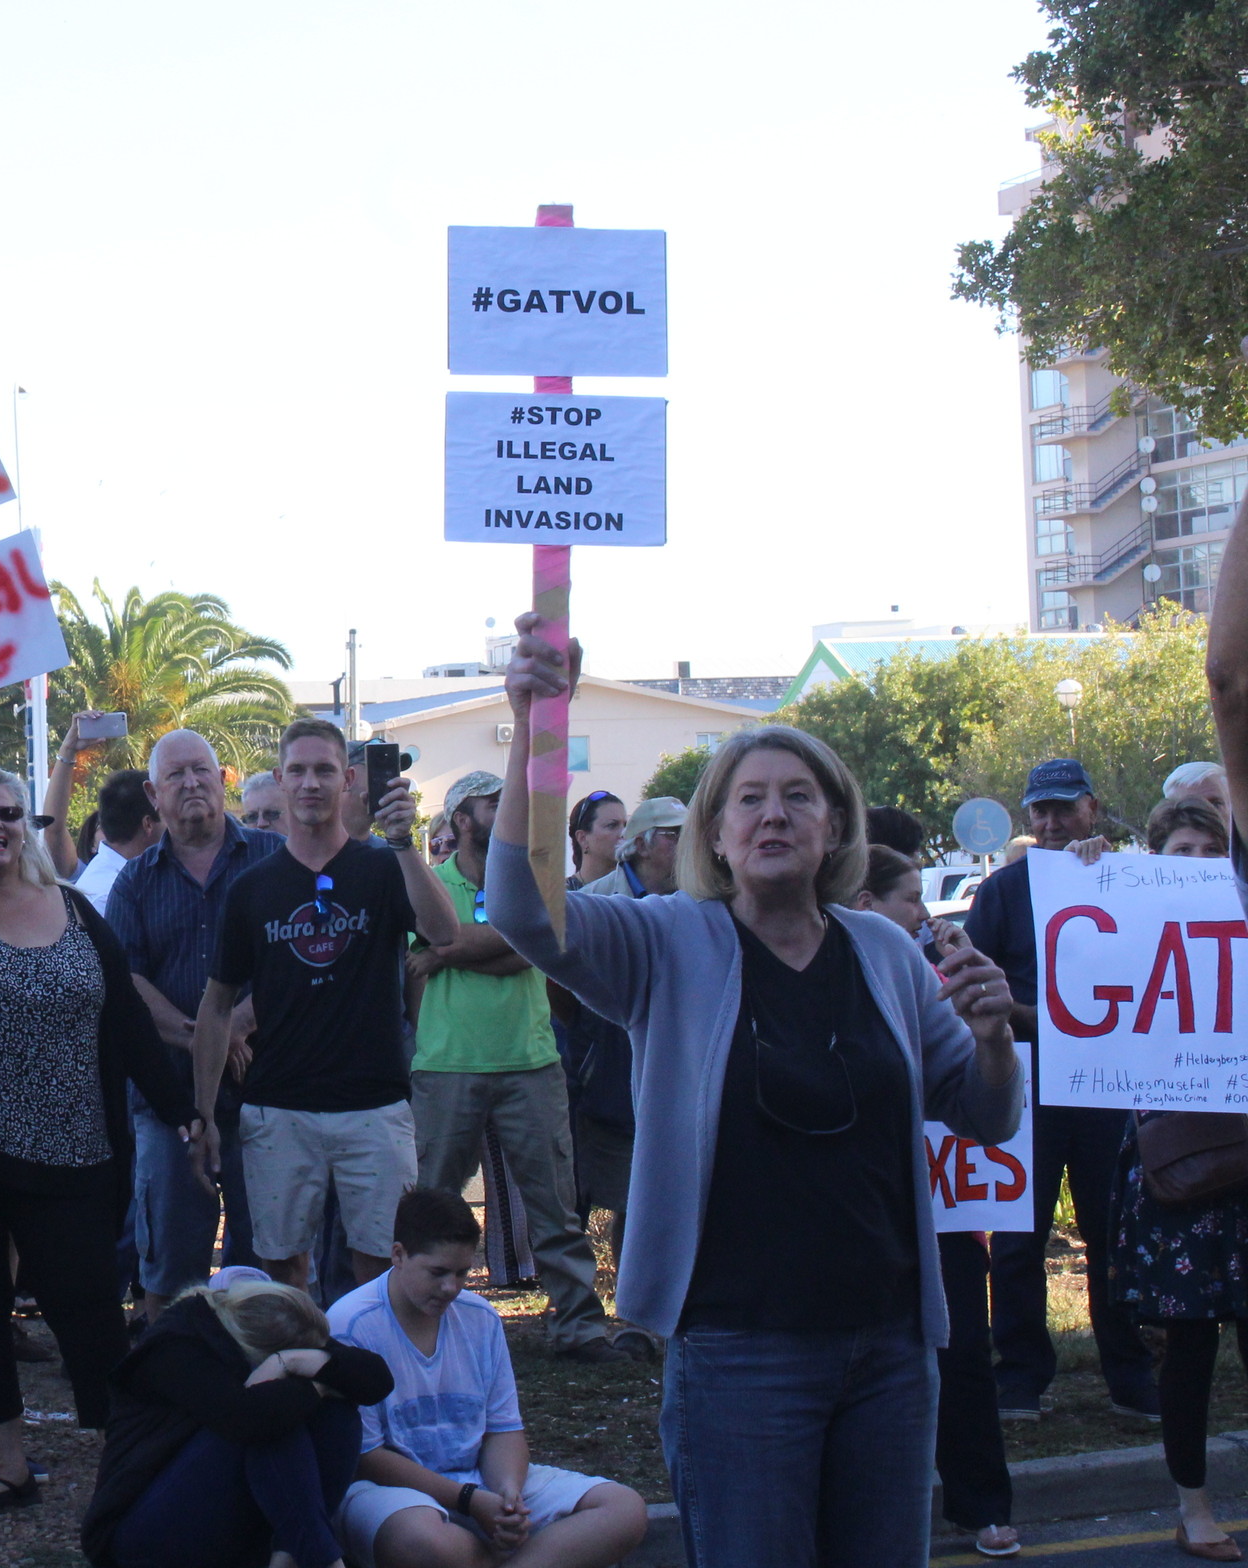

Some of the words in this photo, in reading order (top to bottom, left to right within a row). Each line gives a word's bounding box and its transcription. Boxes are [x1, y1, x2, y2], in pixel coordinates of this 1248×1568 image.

[472, 287, 645, 315] #GATVOL
[511, 406, 602, 426] #STOP
[497, 440, 615, 461] ILLEGAL
[517, 475, 593, 495] LAND
[484, 509, 623, 531] INVASION
[308, 941, 335, 954] CAFE
[1045, 904, 1248, 1039] GAT
